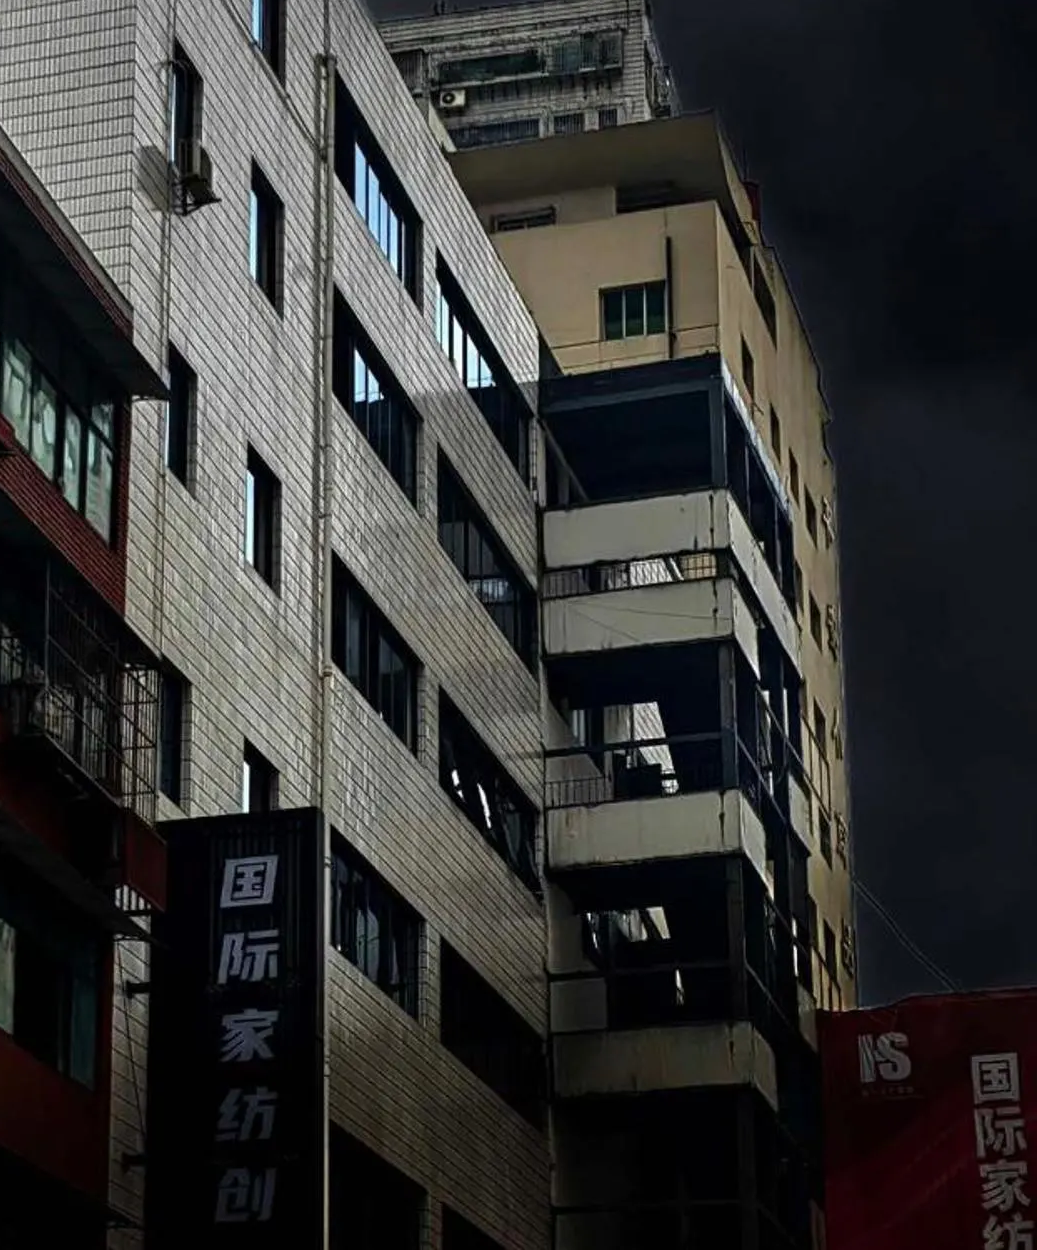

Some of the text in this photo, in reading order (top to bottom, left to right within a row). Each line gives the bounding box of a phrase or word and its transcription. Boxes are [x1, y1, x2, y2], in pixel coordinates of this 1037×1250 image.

[213, 853, 280, 1226] 国际家纺创
